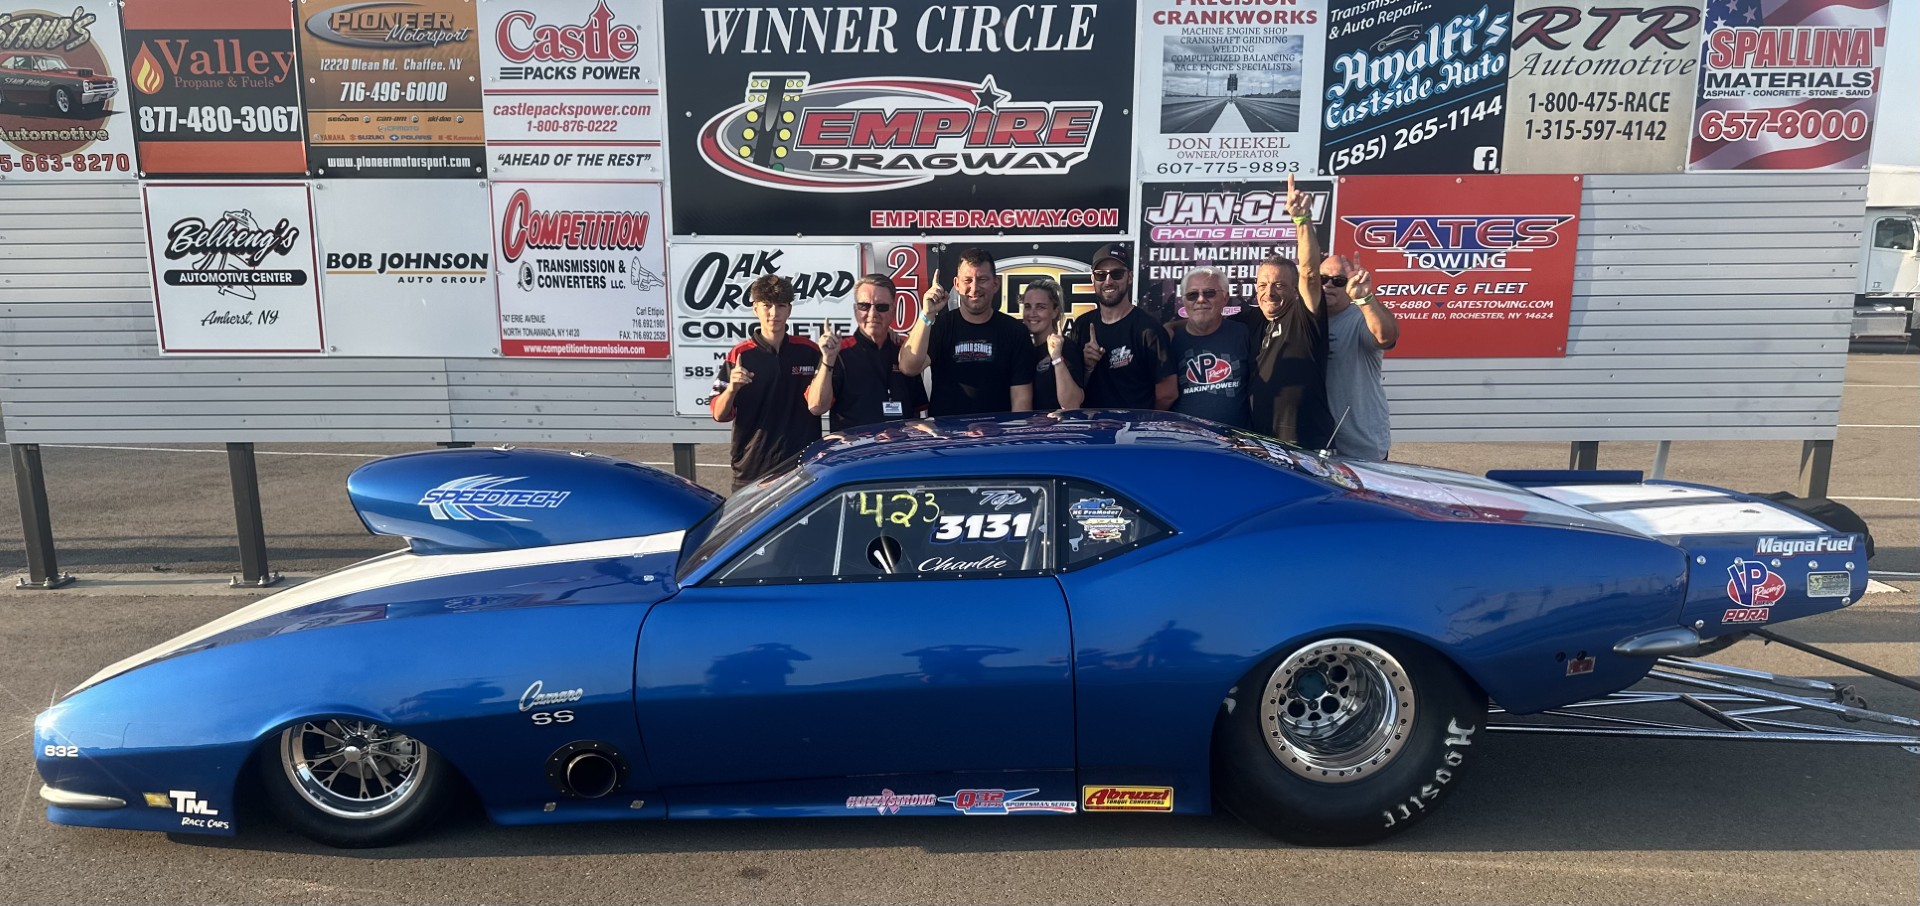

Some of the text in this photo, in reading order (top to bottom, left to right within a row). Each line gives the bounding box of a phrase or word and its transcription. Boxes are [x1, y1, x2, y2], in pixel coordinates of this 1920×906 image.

[331, 12, 453, 30] PIONEER
[1153, 10, 1318, 25] CRANKWORKS
[384, 24, 473, 47] Motorsport
[495, 0, 639, 63] Castle
[701, 4, 1098, 54] WINNER CIRCLE
[1181, 27, 1288, 35] MACHINE ENGINE SHOP
[1329, 26, 1340, 40] &
[1341, 17, 1374, 37] Auto
[1511, 6, 1701, 51] RTR
[1180, 36, 1288, 44] CRANKSHAFT GRINDING
[1212, 45, 1254, 53] WELDING
[1327, 4, 1511, 99] Amalfi's
[1709, 28, 1873, 69] SPALLINA
[154, 39, 295, 83] Valley
[320, 59, 348, 71] 12220
[351, 59, 380, 70] Olean
[448, 58, 463, 70] NY
[1171, 54, 1295, 62] COMPUTERIZED BALANCING
[1508, 51, 1697, 79] Automotive
[523, 66, 640, 80] PACKS POWER
[1174, 63, 1292, 71] RACE ENGINE SPECIALISTS
[174, 76, 274, 89] Propane & Fuels
[1706, 72, 1872, 88] MATERIALS
[1324, 51, 1507, 130] Eastside Auto
[1528, 91, 1670, 113] 1-800-475-RACE
[493, 103, 651, 118] castlepackspower.com
[139, 105, 299, 133] 877-480-3067
[526, 120, 618, 132] 1-800-876-0222
[797, 104, 1099, 150] EMPIRE
[1700, 109, 1868, 141] 657-8000
[1328, 95, 1502, 175] (585) 265-1144
[1525, 119, 1667, 140] 1-315-597-4142
[1168, 137, 1290, 150] DON KIEKEL
[553, 154, 572, 166] OF
[580, 154, 605, 166] THE
[811, 151, 1084, 170] DRAGWAY
[1177, 150, 1279, 159] OWNER/OPERATOR
[0, 154, 130, 173] 5-663-8270
[1157, 161, 1300, 174] 607-775-9893
[870, 208, 1119, 228] EMPIREDRAGWAY.COM
[1157, 227, 1297, 239] RACING ENGINE
[1354, 219, 1559, 248] GATES
[165, 217, 299, 266] Bellreng's
[1149, 247, 1271, 261] FULL MACHINE
[1403, 253, 1507, 268] TOWING
[326, 253, 489, 274] BOB JOHNSON
[536, 259, 626, 273] TRANSMISSION &
[179, 273, 292, 283] AUTOMOTIVE CENTER
[537, 275, 607, 289] CONVERTERS
[684, 249, 784, 310] OAK
[1375, 282, 1528, 296] SERVICE & FLEET
[1382, 300, 1554, 309] 35-6880 GATESTOWING.COM
[201, 310, 279, 326] Amherst, NY
[1431, 312, 1447, 320] RD,
[1450, 312, 1505, 320] ROCHESTER,
[524, 344, 645, 356] www.competitiontransmission.com
[685, 367, 714, 377] 585
[1187, 353, 1217, 384] VP
[419, 490, 571, 508] SPEEDTECH
[932, 513, 1031, 543] 3131
[1757, 536, 1856, 556] MagnaFuel
[918, 556, 1008, 572] Charlie
[1727, 561, 1768, 606] VP
[1722, 608, 1769, 622] PDRA
[519, 680, 583, 711] Camaro
[531, 710, 575, 725] SS
[169, 790, 218, 815] TML
[1086, 788, 1170, 804] Abruzzi
